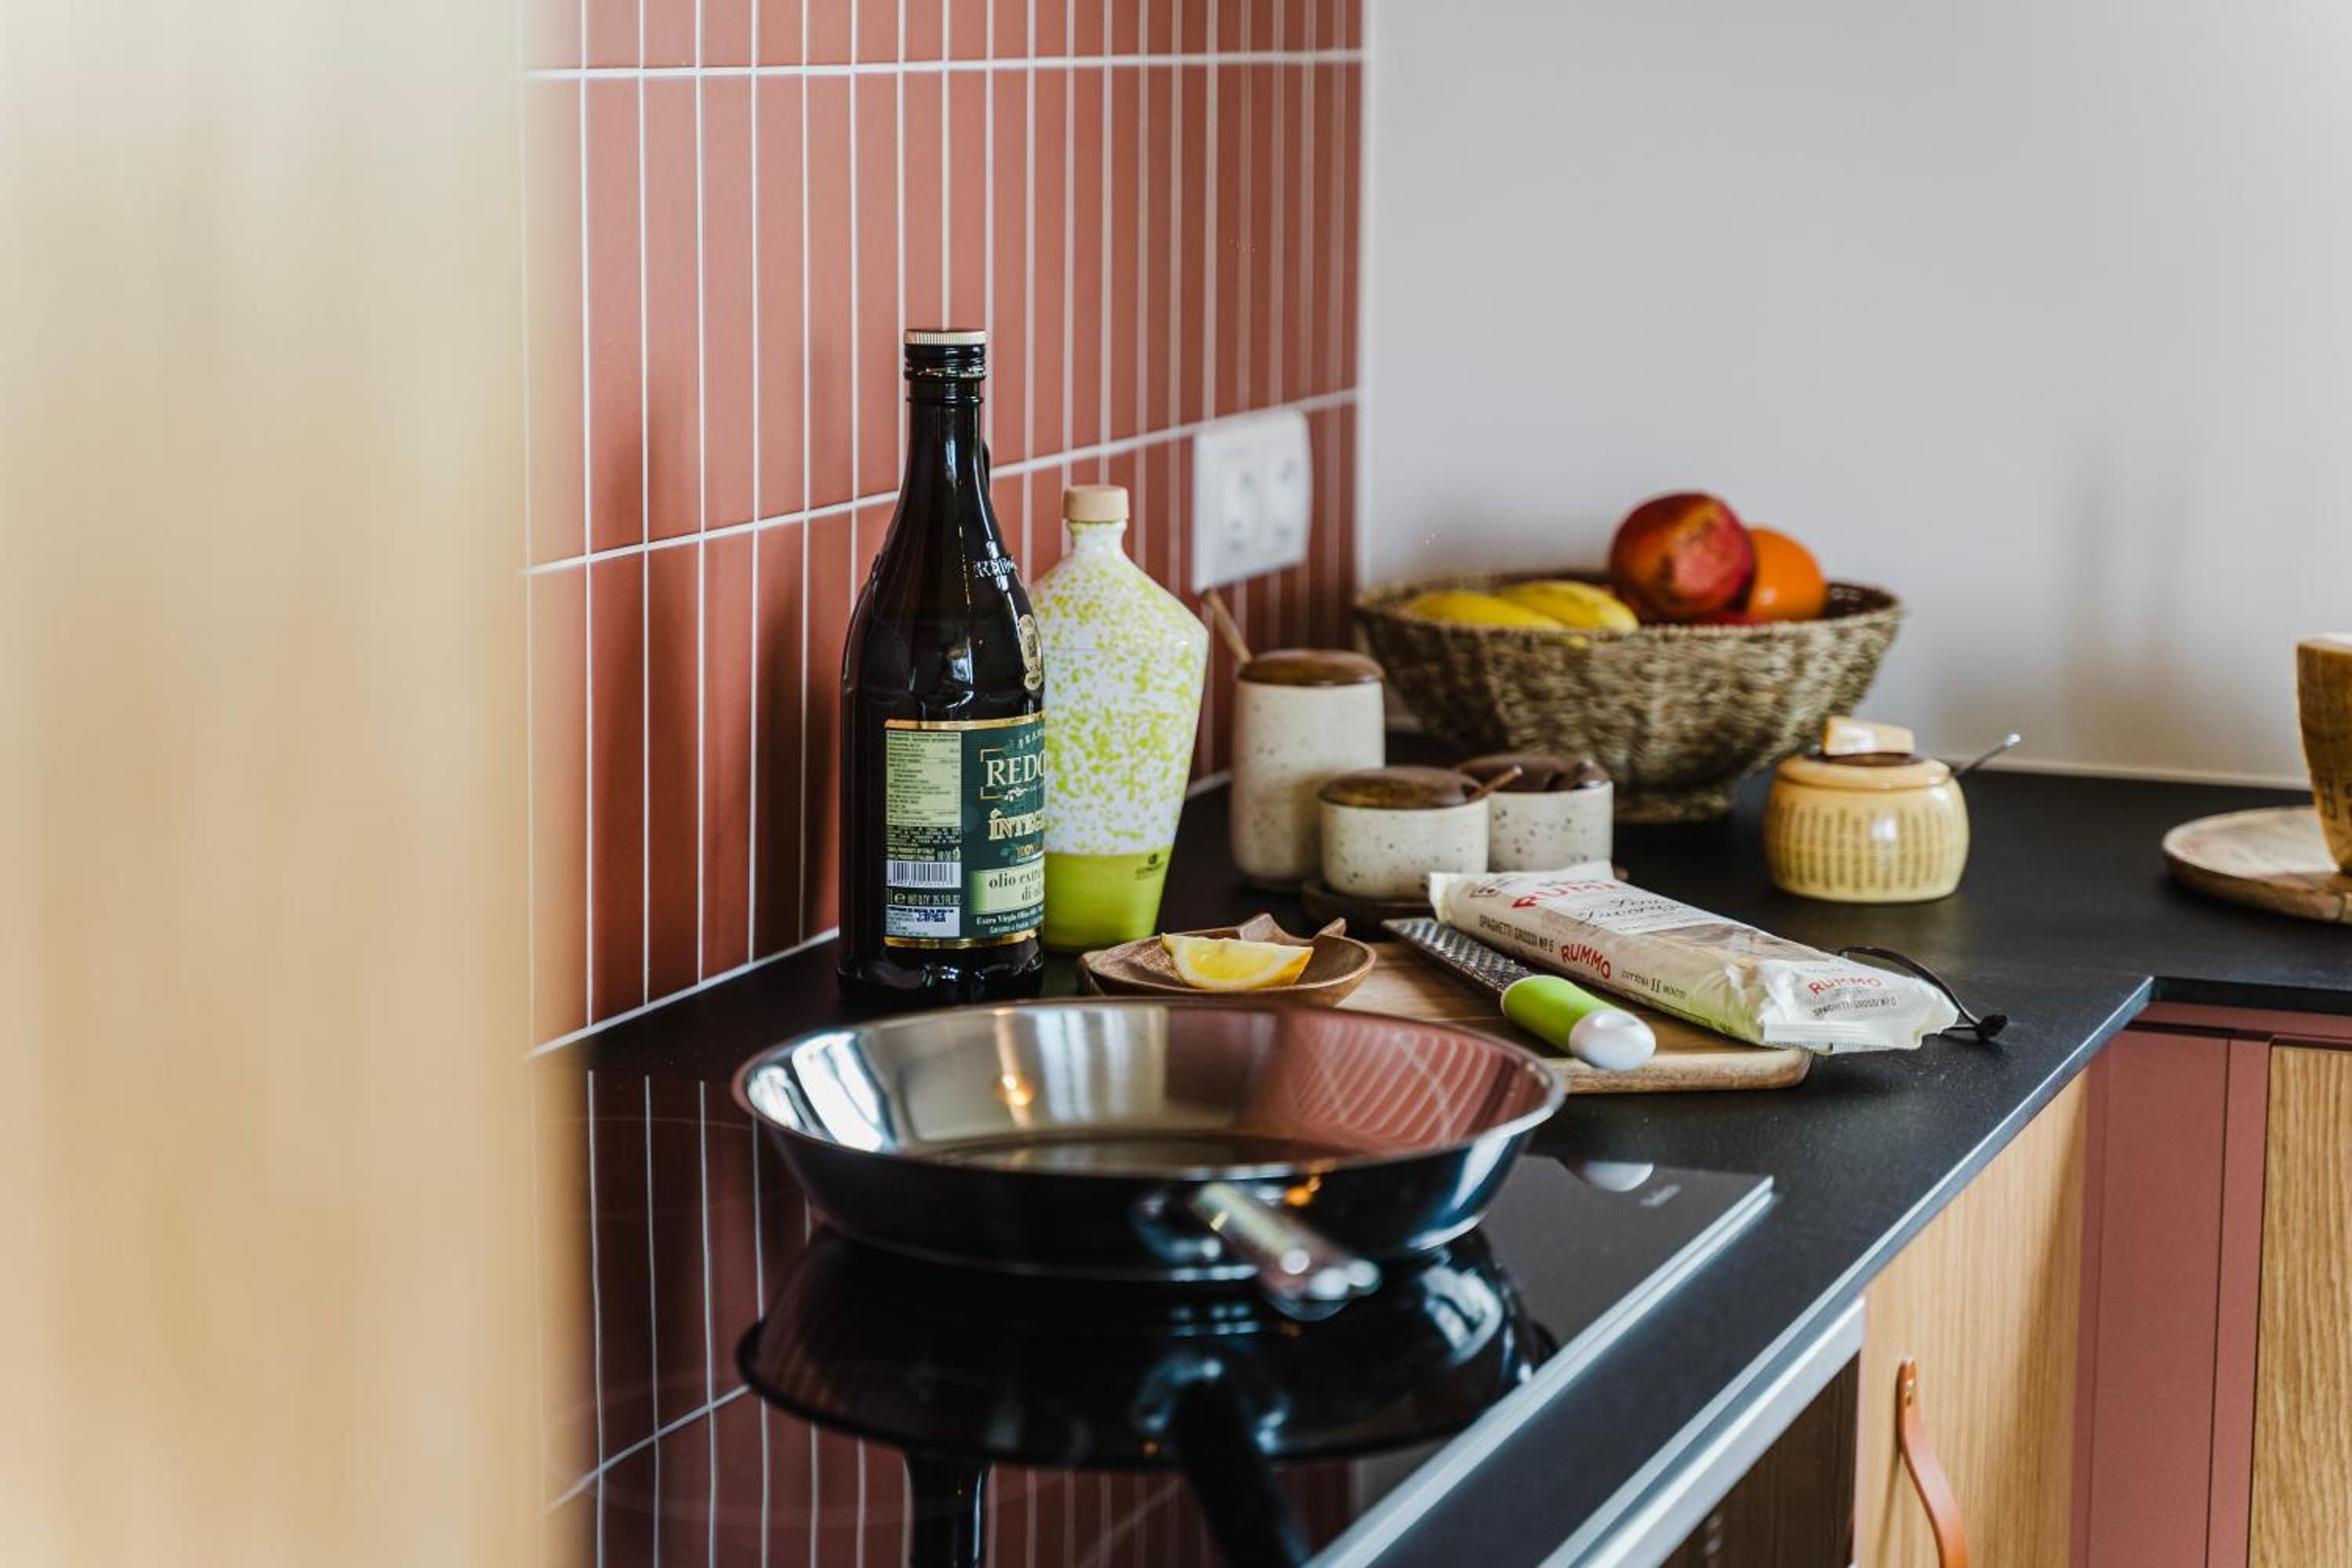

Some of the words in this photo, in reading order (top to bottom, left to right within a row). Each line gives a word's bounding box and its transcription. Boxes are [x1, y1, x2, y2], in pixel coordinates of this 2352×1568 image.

[985, 750, 1046, 787] REDO
[989, 812, 1045, 840] INTEG
[989, 873, 1017, 890] olio
[1479, 914, 1513, 937] SPAGHETTI
[1561, 943, 1612, 979] RUMMO
[1807, 978, 1882, 995] RUMMO
